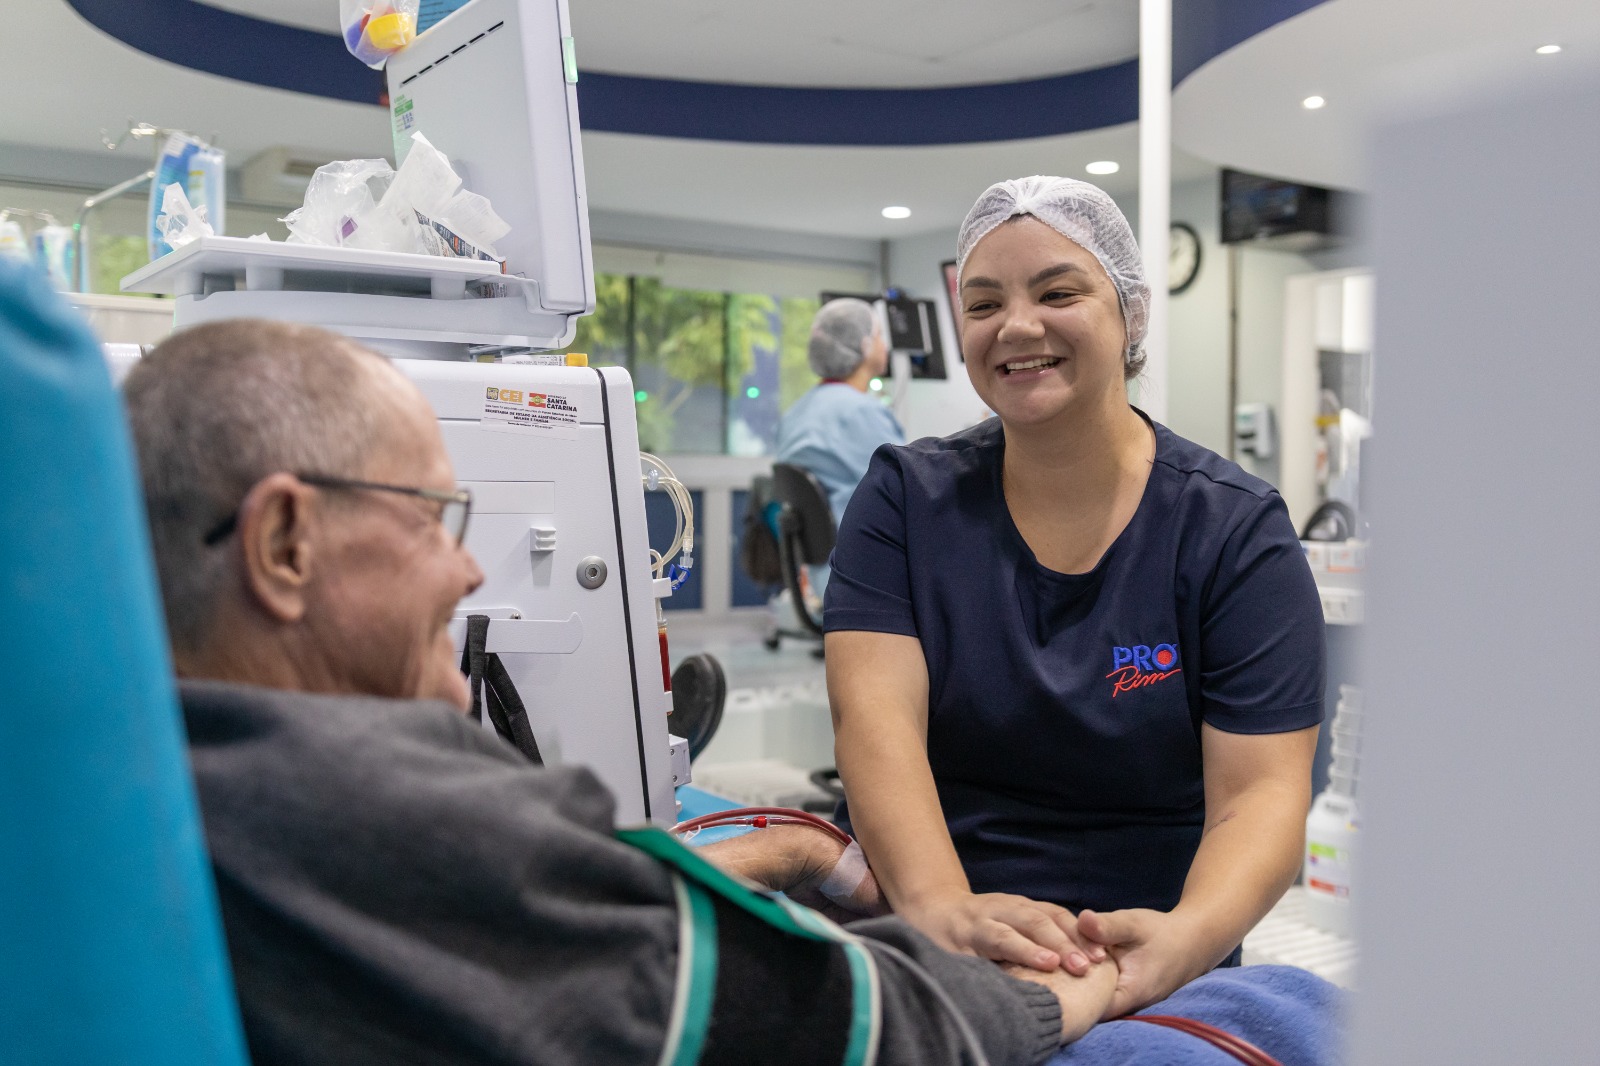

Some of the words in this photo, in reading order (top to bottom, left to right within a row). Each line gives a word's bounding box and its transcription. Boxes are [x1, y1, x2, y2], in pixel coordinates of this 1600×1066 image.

[500, 389, 523, 402] CEI
[547, 404, 577, 412] CATARINA
[1113, 643, 1178, 671] PRO
[1105, 665, 1181, 698] Rim
